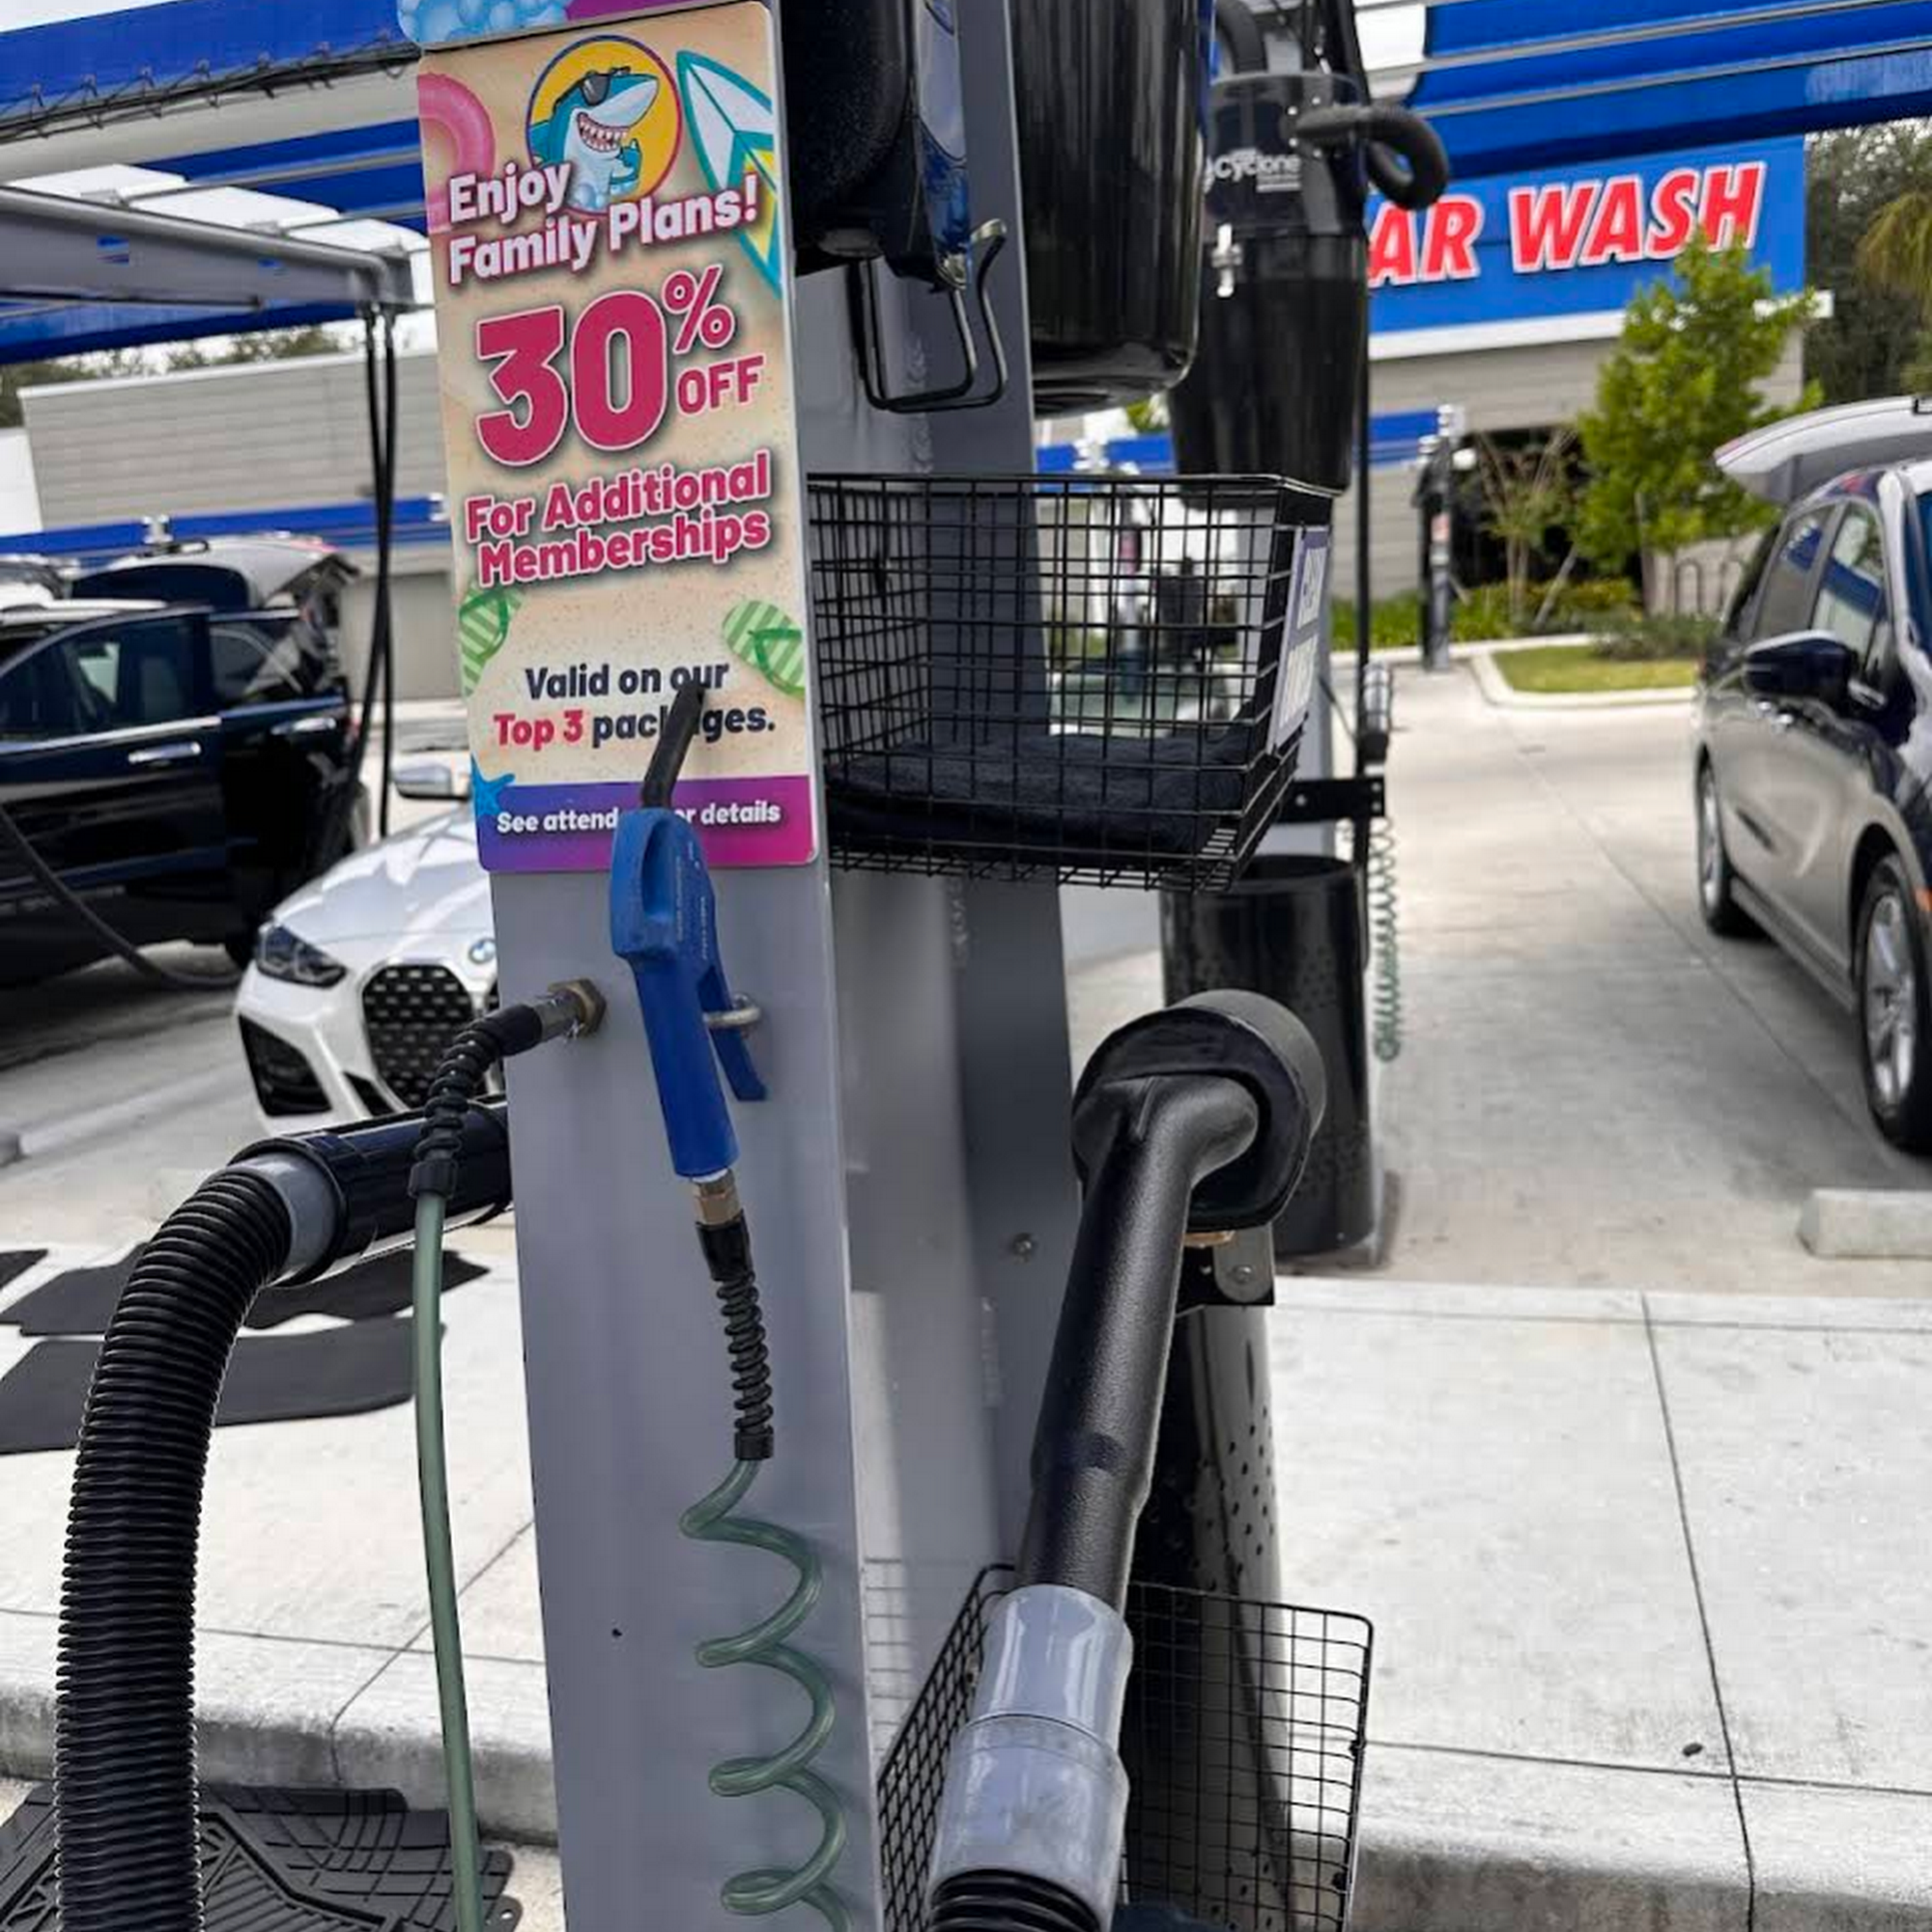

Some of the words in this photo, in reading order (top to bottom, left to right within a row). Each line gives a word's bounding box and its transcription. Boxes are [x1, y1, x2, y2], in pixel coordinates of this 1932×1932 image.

[448, 162, 572, 224] Enjoy
[449, 213, 597, 284] Family
[609, 174, 757, 251] Plans!
[1366, 194, 1485, 289] AR
[1509, 160, 1767, 274] WASH
[677, 355, 764, 415] OFF
[466, 497, 535, 544] For
[543, 449, 771, 531] Additional
[478, 508, 771, 587] Memberships
[525, 664, 610, 700] Valid
[618, 668, 661, 695] on
[670, 663, 729, 692] our
[494, 712, 554, 751] Top
[563, 709, 583, 744] 3
[592, 704, 776, 749] pacges.
[497, 810, 538, 833] See
[543, 808, 618, 832] attend
[700, 800, 781, 825] details
